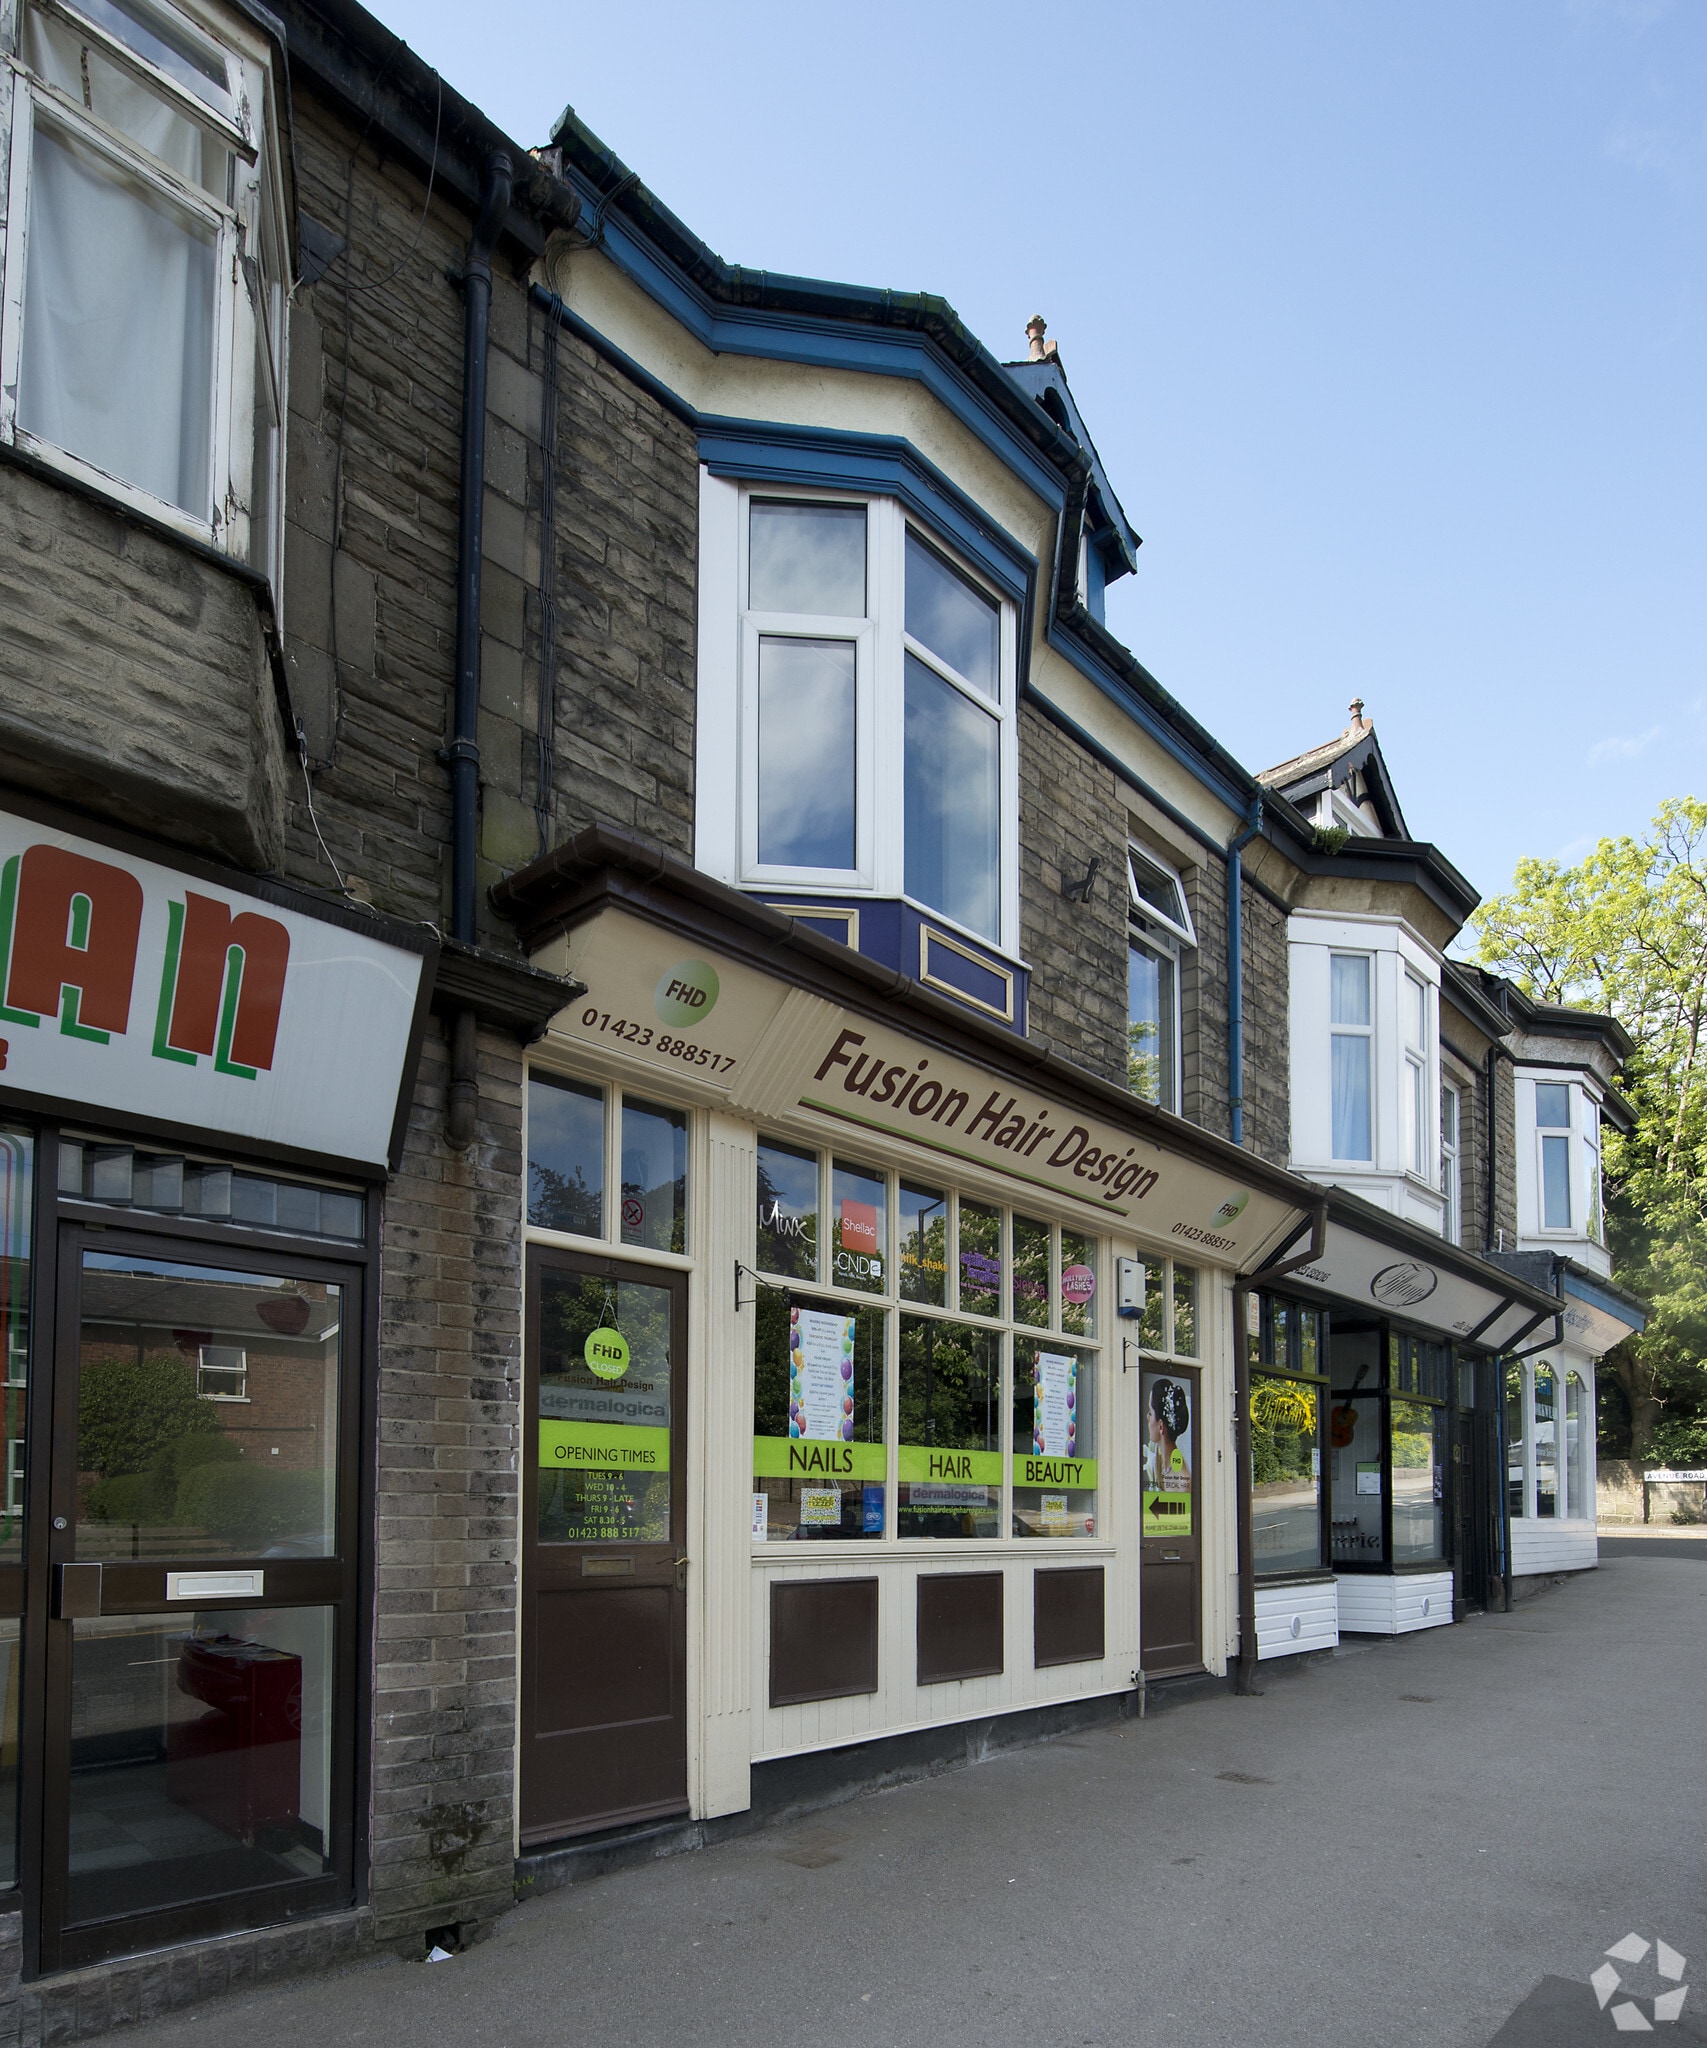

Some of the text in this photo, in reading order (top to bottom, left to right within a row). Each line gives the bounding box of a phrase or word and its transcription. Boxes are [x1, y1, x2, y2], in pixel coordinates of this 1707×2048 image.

[665, 979, 707, 1008] FHD
[581, 1008, 736, 1074] 01423 888517
[813, 1028, 1160, 1201] Fusion Hair Design
[1218, 1203, 1238, 1217] FHD
[843, 1217, 876, 1237] Shellac
[1171, 1222, 1236, 1251] 01423 888517
[837, 1252, 870, 1275] CND
[1066, 1281, 1092, 1291] LASHES
[592, 1343, 623, 1360] FHD
[589, 1361, 623, 1375] CLOSED
[557, 1374, 654, 1392] Fusion Hair Design
[541, 1392, 665, 1417] dermalogica
[554, 1445, 656, 1463] OPENING TIMES
[789, 1445, 853, 1473] NAILS
[587, 1471, 606, 1480] TUES
[607, 1472, 613, 1480] 9
[618, 1472, 623, 1480] 6
[929, 1454, 973, 1479] HAIR
[1025, 1460, 1083, 1484] BEAUTY
[585, 1483, 603, 1491] WED
[606, 1483, 614, 1491] 10
[621, 1483, 626, 1491] 4
[913, 1488, 985, 1501] dermalogica
[575, 1493, 600, 1502] THURS
[602, 1494, 607, 1502] 9
[614, 1494, 635, 1502] LATE
[591, 1505, 601, 1513] FRI
[603, 1505, 608, 1513] 9
[614, 1506, 619, 1514] 6
[584, 1516, 597, 1524] SAT
[600, 1516, 615, 1524] 8.30
[622, 1516, 626, 1525] 5
[568, 1527, 640, 1538] 01423 888 517
